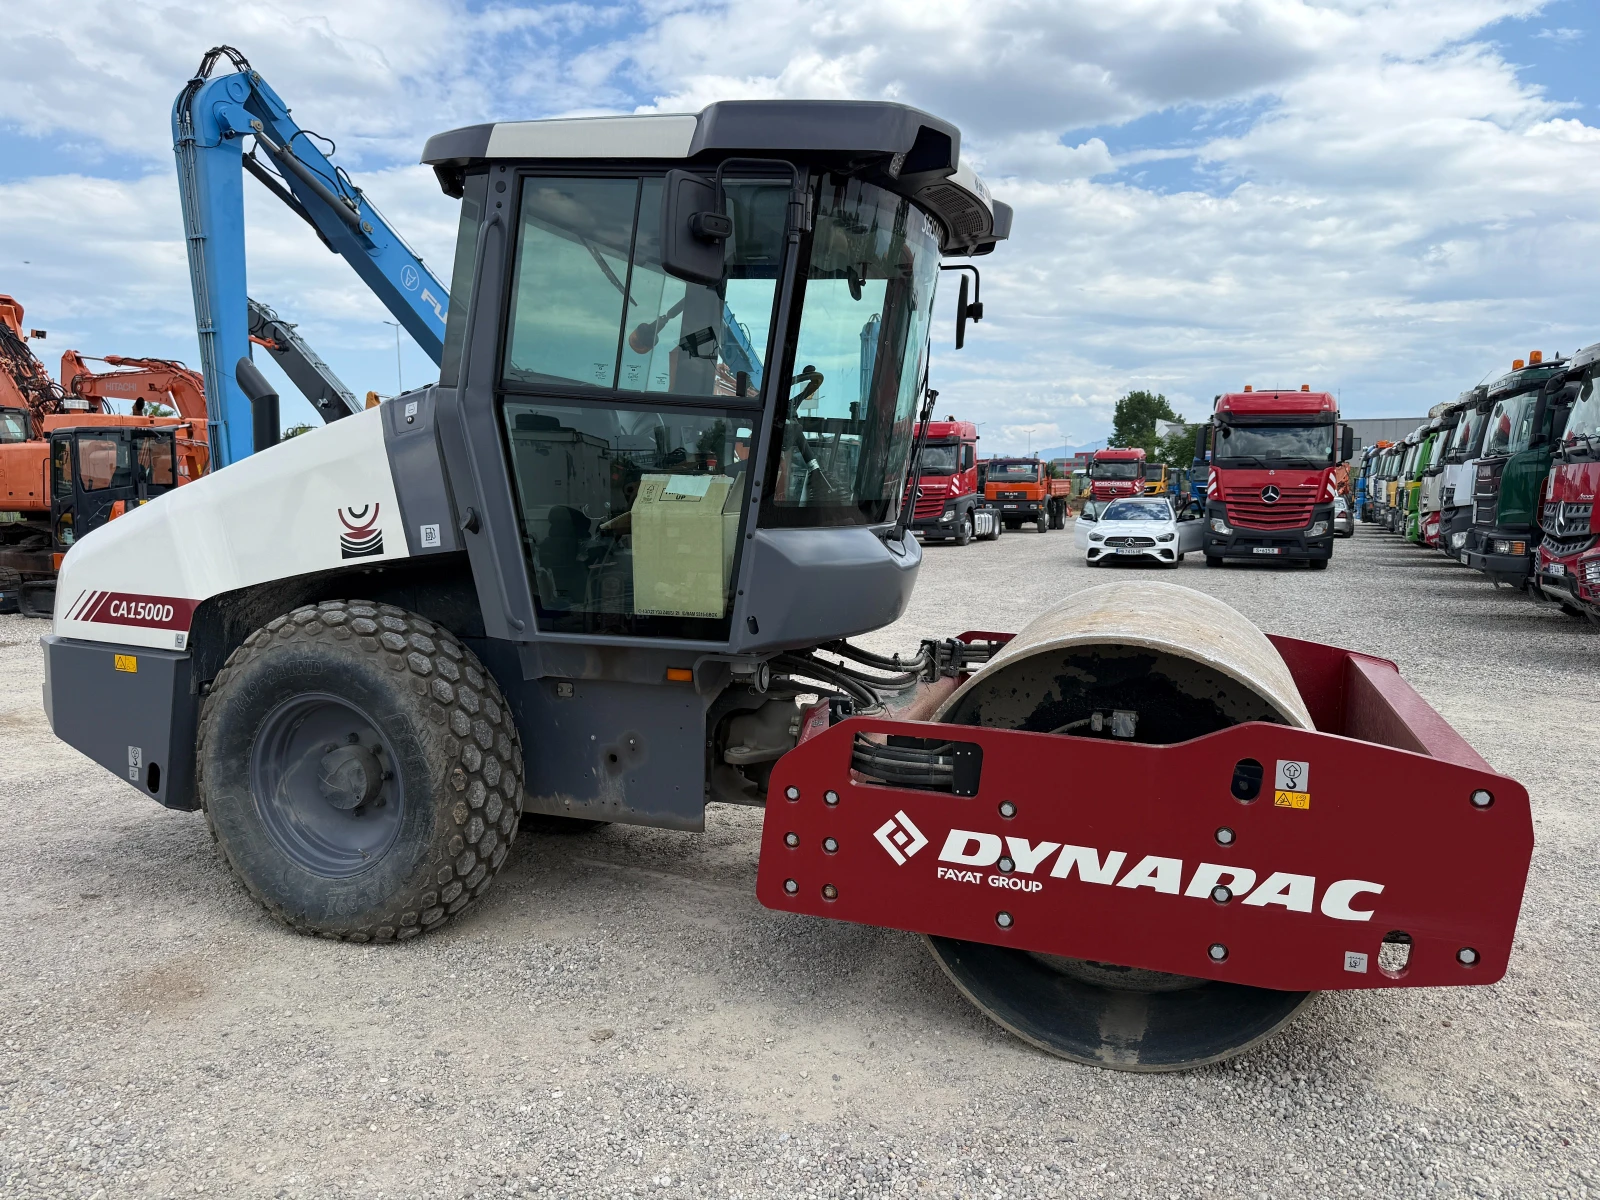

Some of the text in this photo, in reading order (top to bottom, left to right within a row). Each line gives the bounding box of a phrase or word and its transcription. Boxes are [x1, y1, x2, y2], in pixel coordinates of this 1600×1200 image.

[105, 382, 137, 392] HITACHI
[109, 599, 174, 622] CA1500D
[937, 828, 1385, 922] DYNAPAC
[937, 867, 1043, 893] FAYAT GROUP
